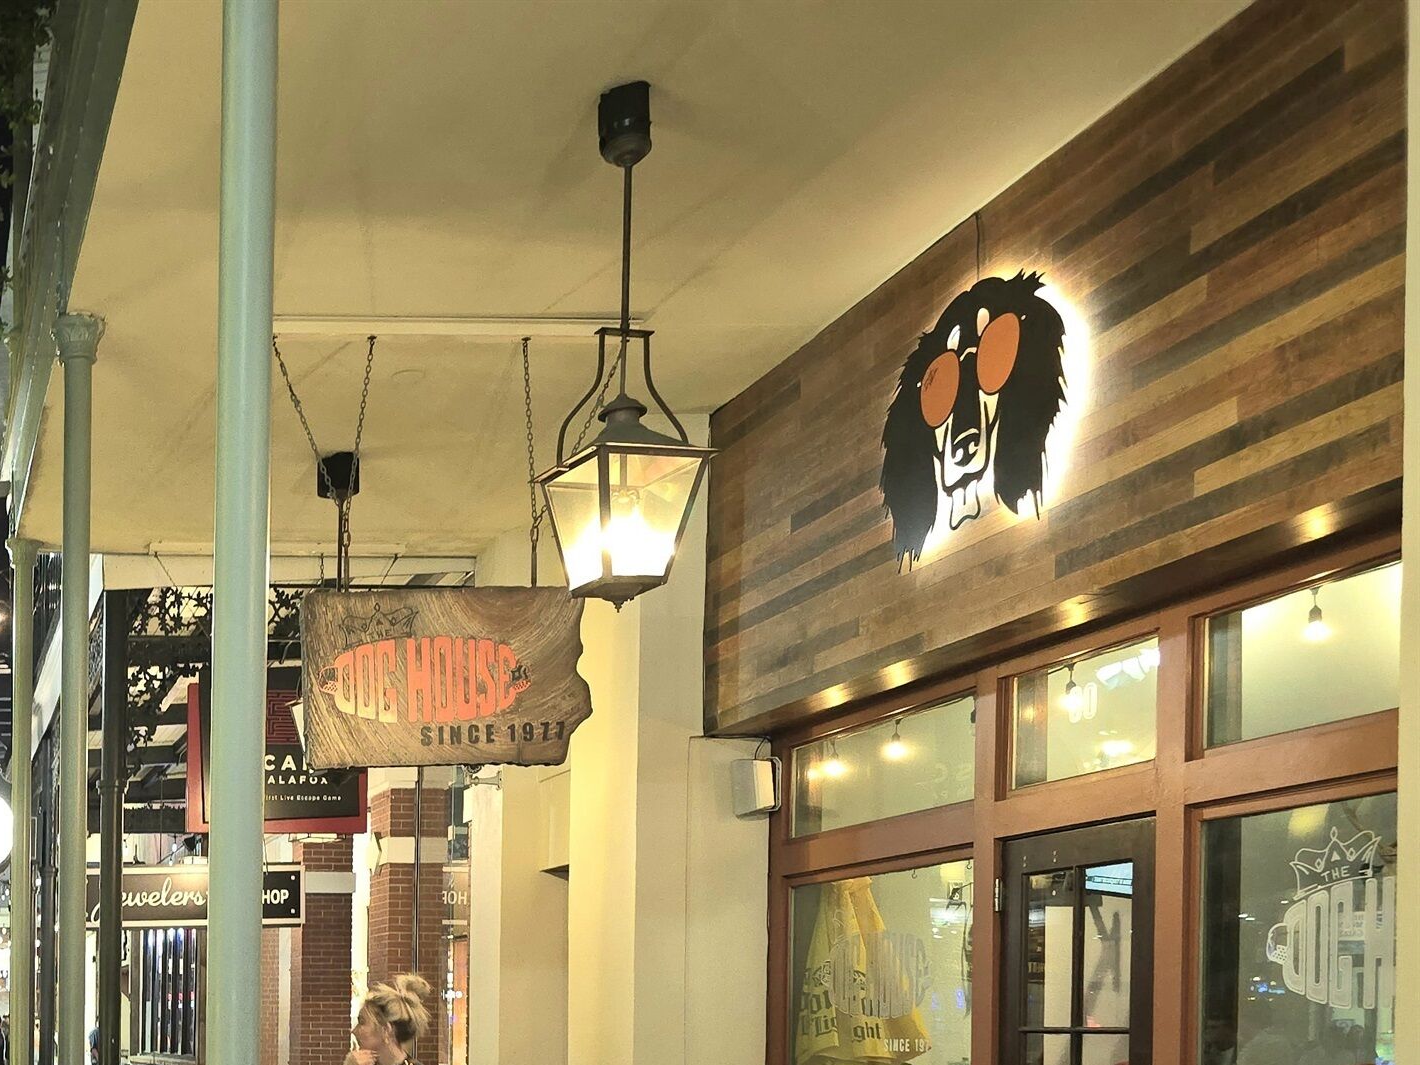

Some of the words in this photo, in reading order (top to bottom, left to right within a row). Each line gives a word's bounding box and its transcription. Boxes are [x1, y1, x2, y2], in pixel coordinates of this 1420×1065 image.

[334, 638, 398, 724] DOG
[406, 635, 517, 723] HOUSE
[420, 724, 495, 747] SINCE
[507, 720, 565, 743] 1977
[267, 775, 328, 785] ALAFOX
[1321, 866, 1351, 882] THE
[262, 889, 290, 905] HOP
[1283, 880, 1353, 1009] DOG
[883, 1038, 910, 1052] SINCE
